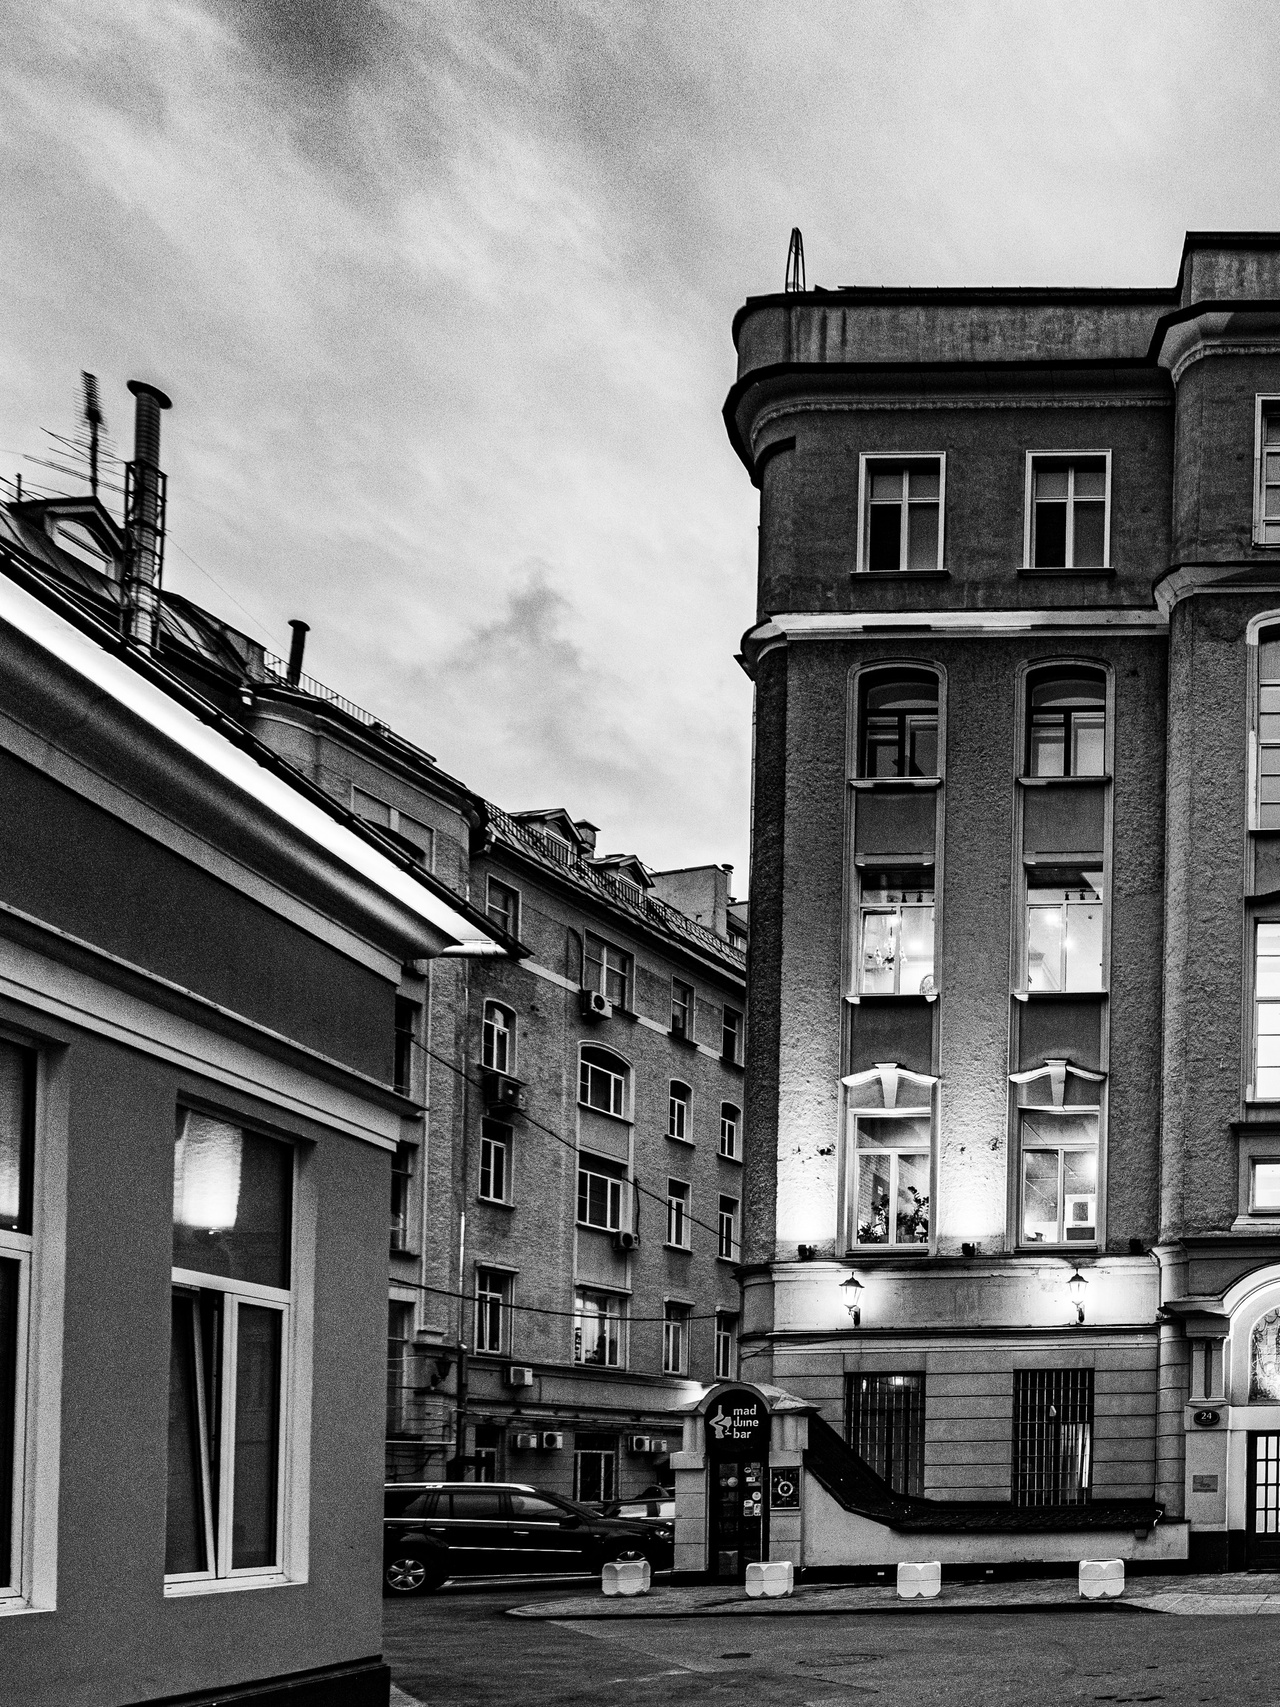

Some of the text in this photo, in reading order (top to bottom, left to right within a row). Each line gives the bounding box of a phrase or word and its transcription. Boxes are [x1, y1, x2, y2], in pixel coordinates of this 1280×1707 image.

[733, 1404, 757, 1416] mad
[733, 1416, 759, 1427] wine
[1201, 1412, 1212, 1420] 24
[733, 1427, 752, 1439] bar
